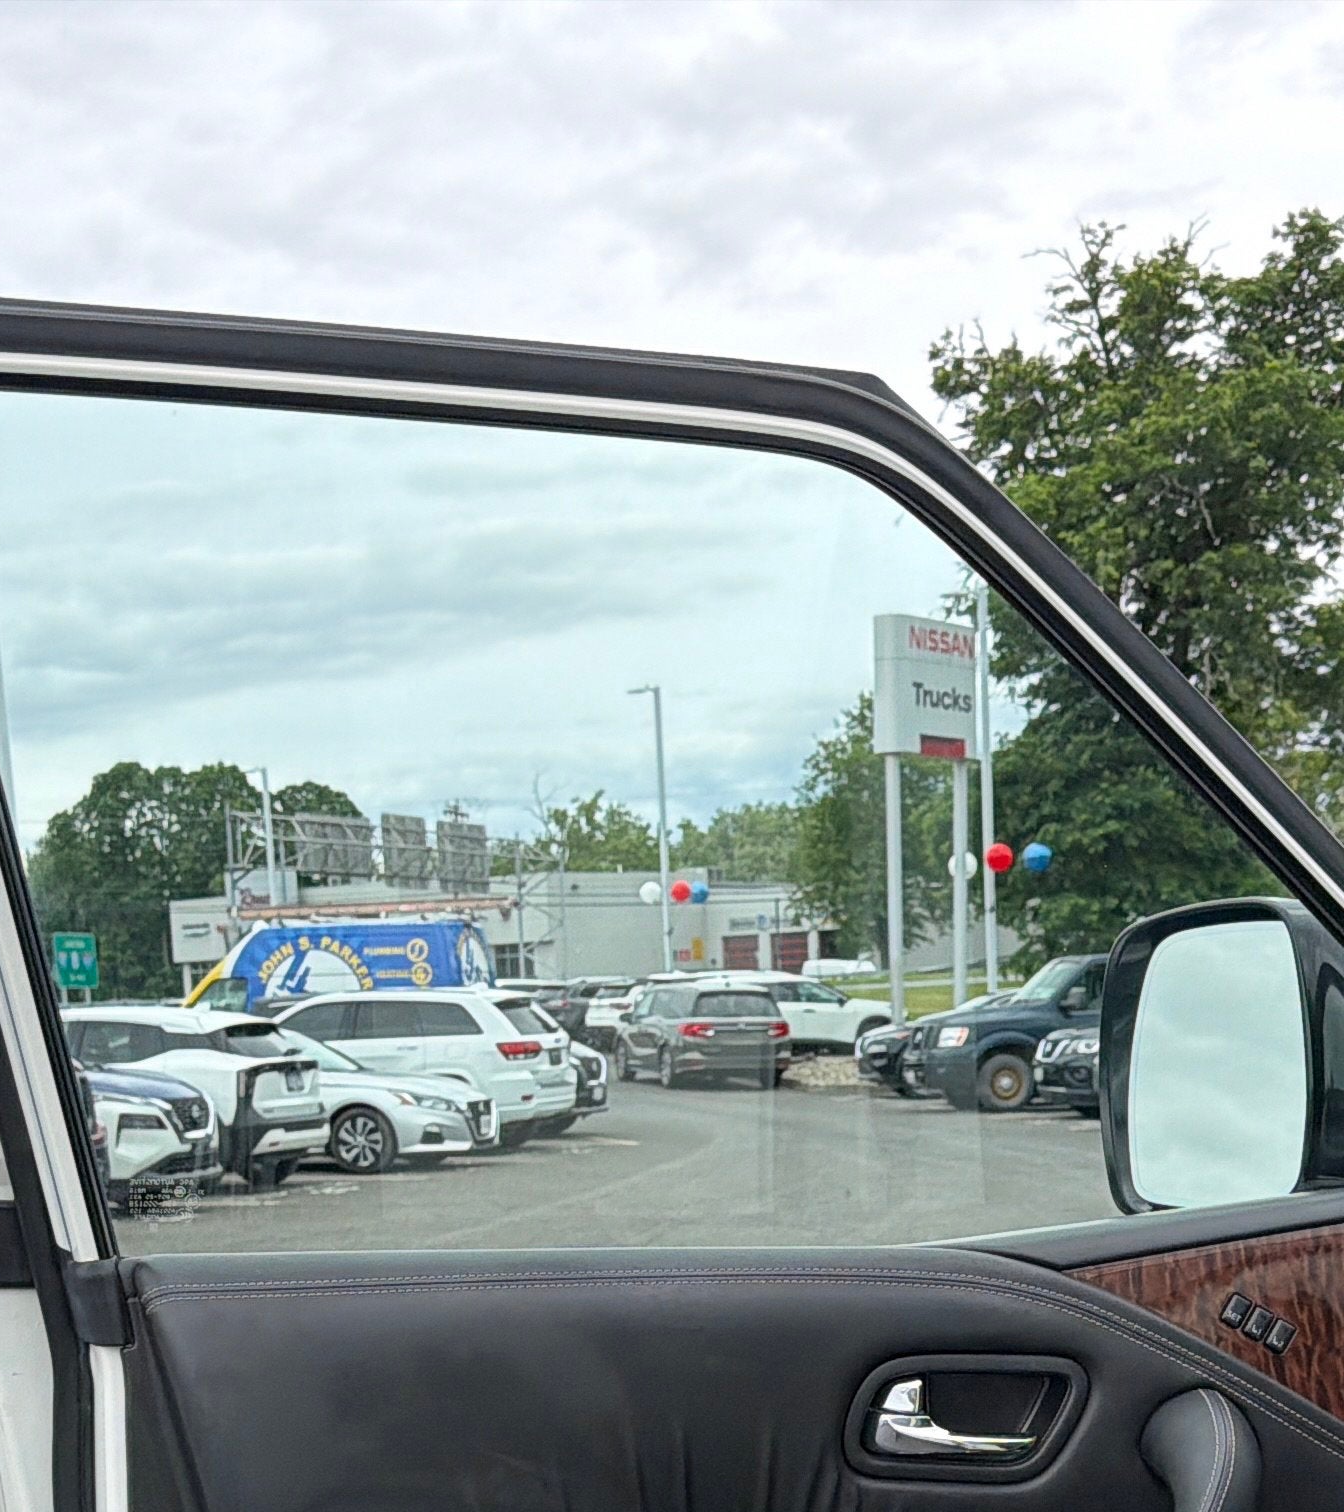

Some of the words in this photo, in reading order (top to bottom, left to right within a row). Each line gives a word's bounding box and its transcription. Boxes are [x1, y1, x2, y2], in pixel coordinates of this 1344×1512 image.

[909, 625, 975, 659] NISSAN
[912, 681, 973, 713] Trucks
[258, 942, 295, 983] JOHN
[297, 936, 314, 950] S.
[320, 936, 374, 990] PARKER
